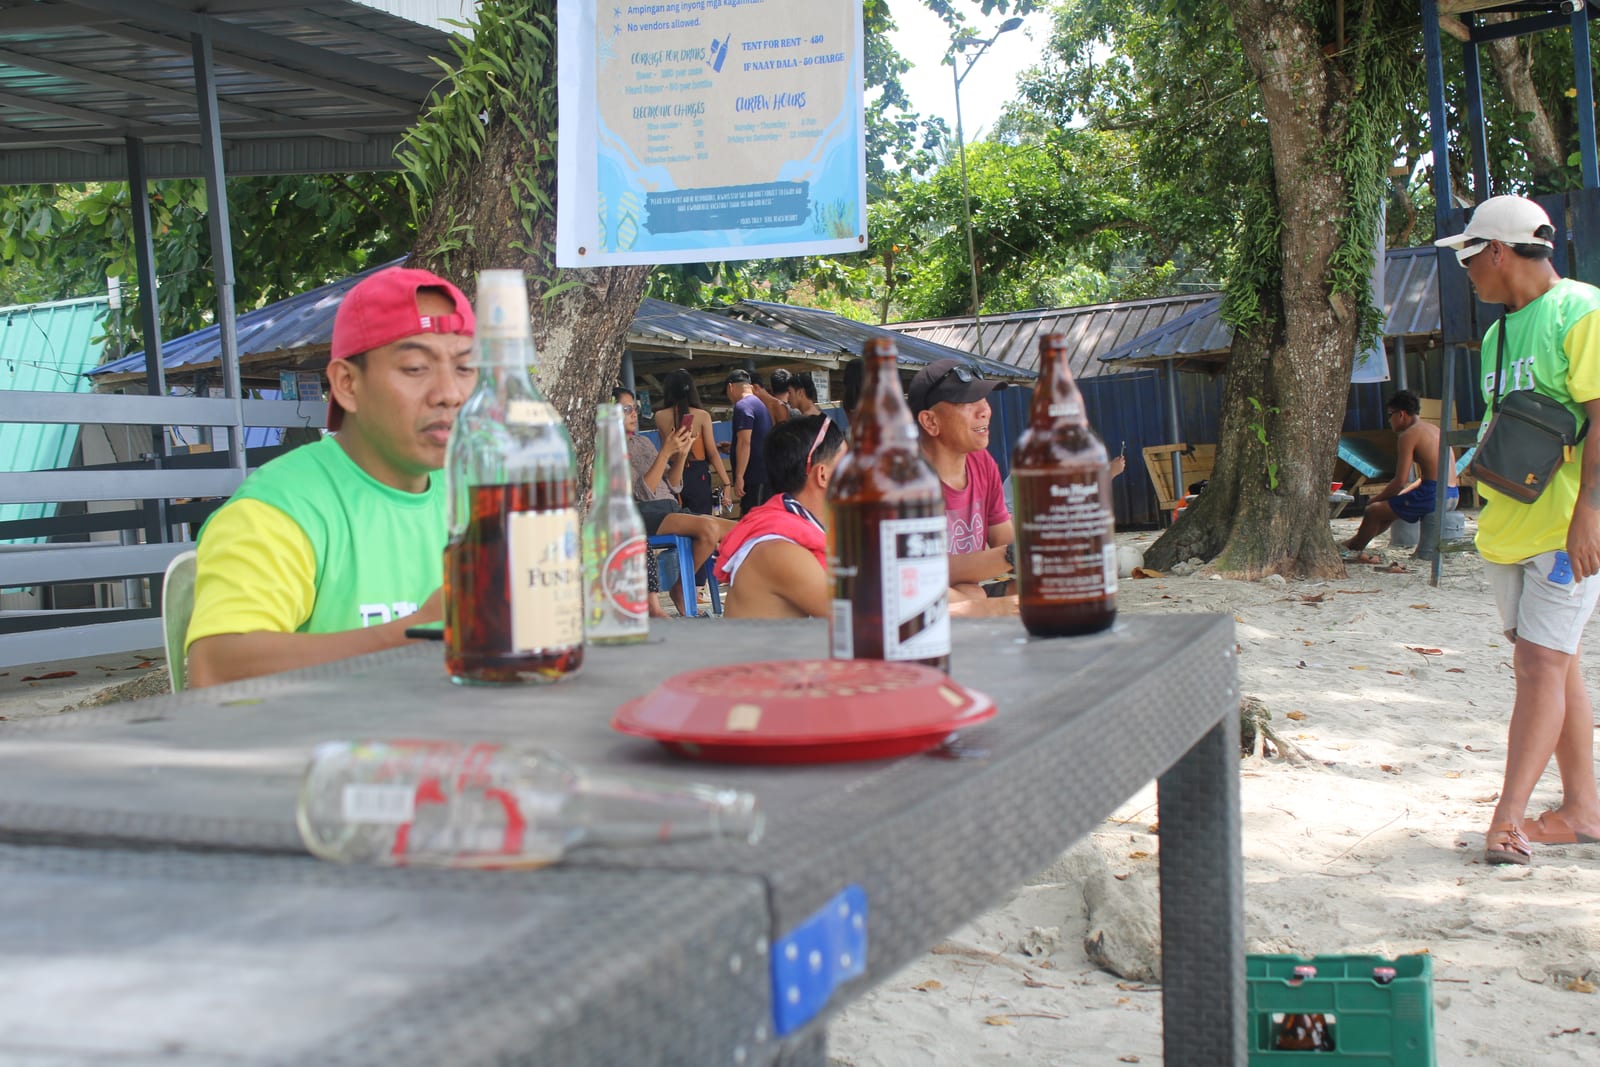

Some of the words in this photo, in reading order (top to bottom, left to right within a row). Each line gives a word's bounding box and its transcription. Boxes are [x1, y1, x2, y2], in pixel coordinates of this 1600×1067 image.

[627, 5, 665, 15] Ampingan
[666, 5, 680, 14] ang
[681, 1, 705, 12] inyong
[706, 0, 721, 9] mga
[627, 23, 638, 32] No
[639, 20, 669, 31] vendors
[671, 17, 701, 28] allowed.
[741, 40, 762, 51] TENT
[763, 39, 779, 49] FOR
[780, 37, 801, 47] RENT
[743, 63, 751, 72] IF
[752, 60, 775, 71] NAAY
[776, 58, 798, 68] DALA
[814, 52, 845, 64] CHARGE
[773, 91, 806, 110] HOURS
